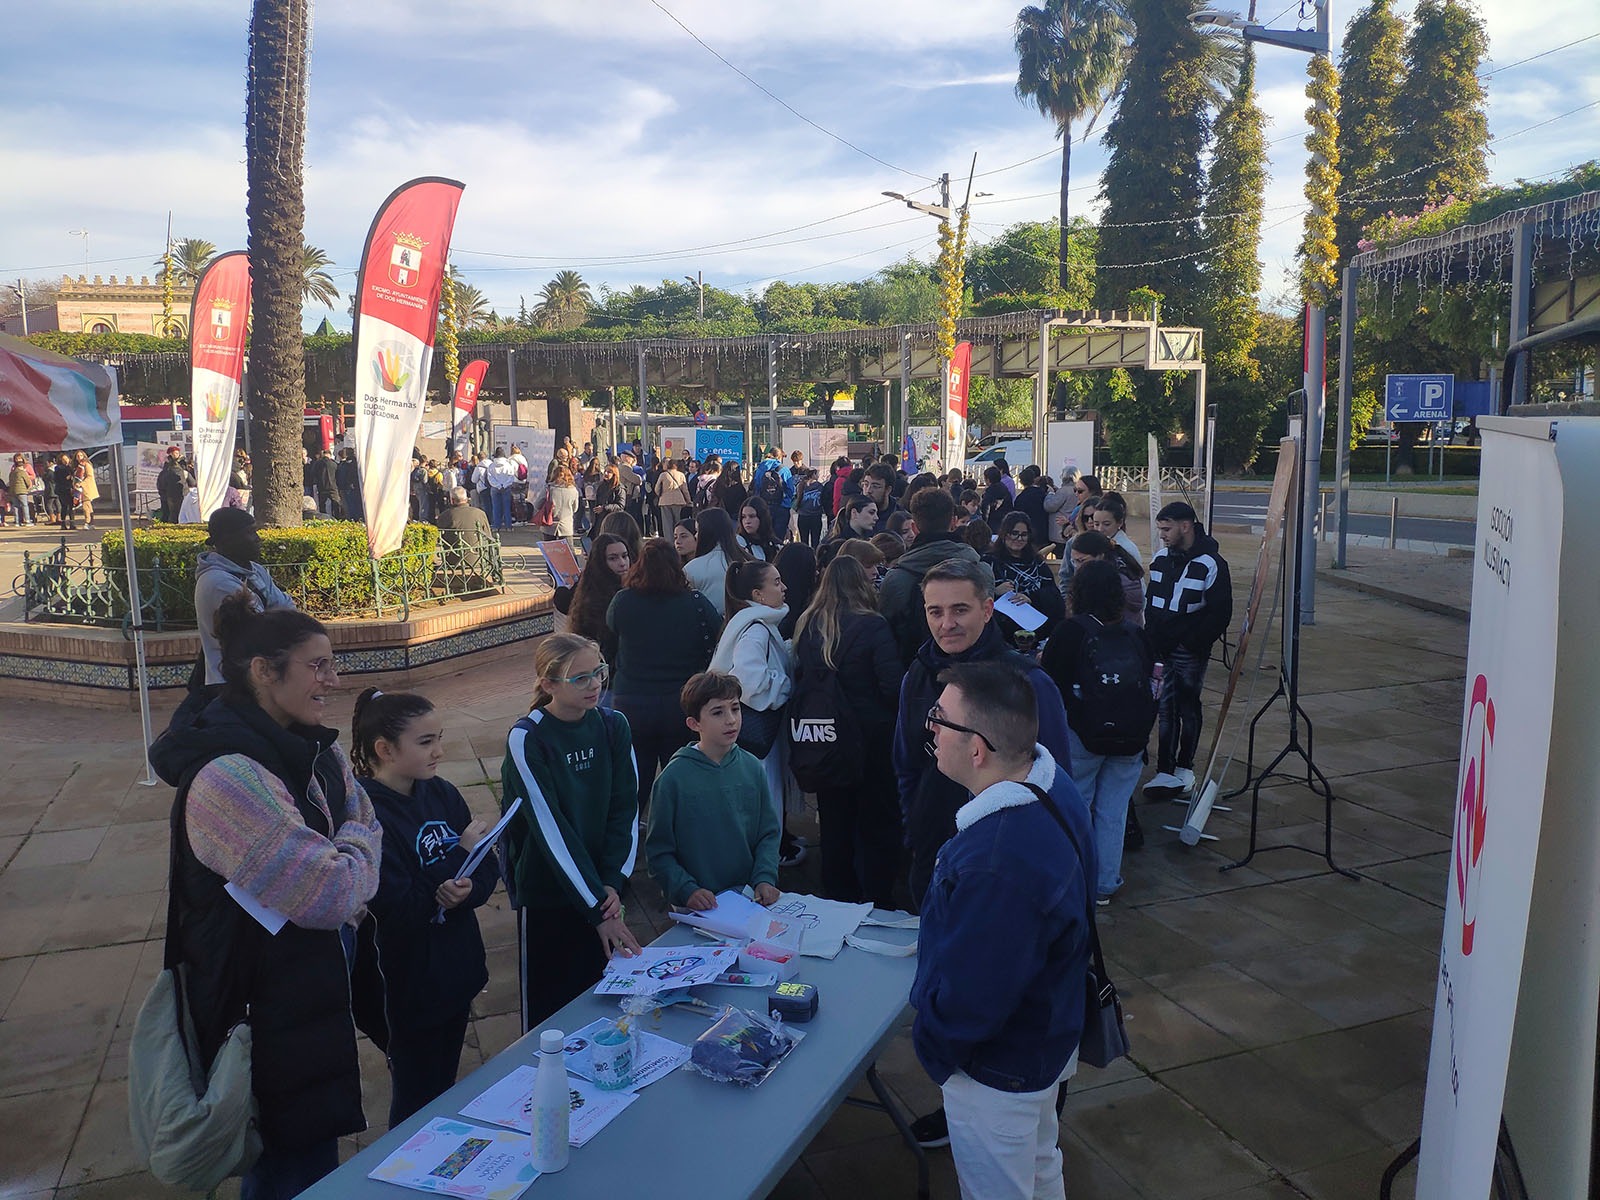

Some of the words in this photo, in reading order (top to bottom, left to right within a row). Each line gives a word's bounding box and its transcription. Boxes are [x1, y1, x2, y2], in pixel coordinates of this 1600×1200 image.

[384, 294, 396, 302] DOS
[396, 298, 423, 310] HERMANAS
[364, 393, 378, 403] Dos
[380, 396, 417, 409] Hermanas
[1425, 384, 1442, 406] P
[790, 717, 837, 743] VANS
[566, 747, 594, 764] FILA
